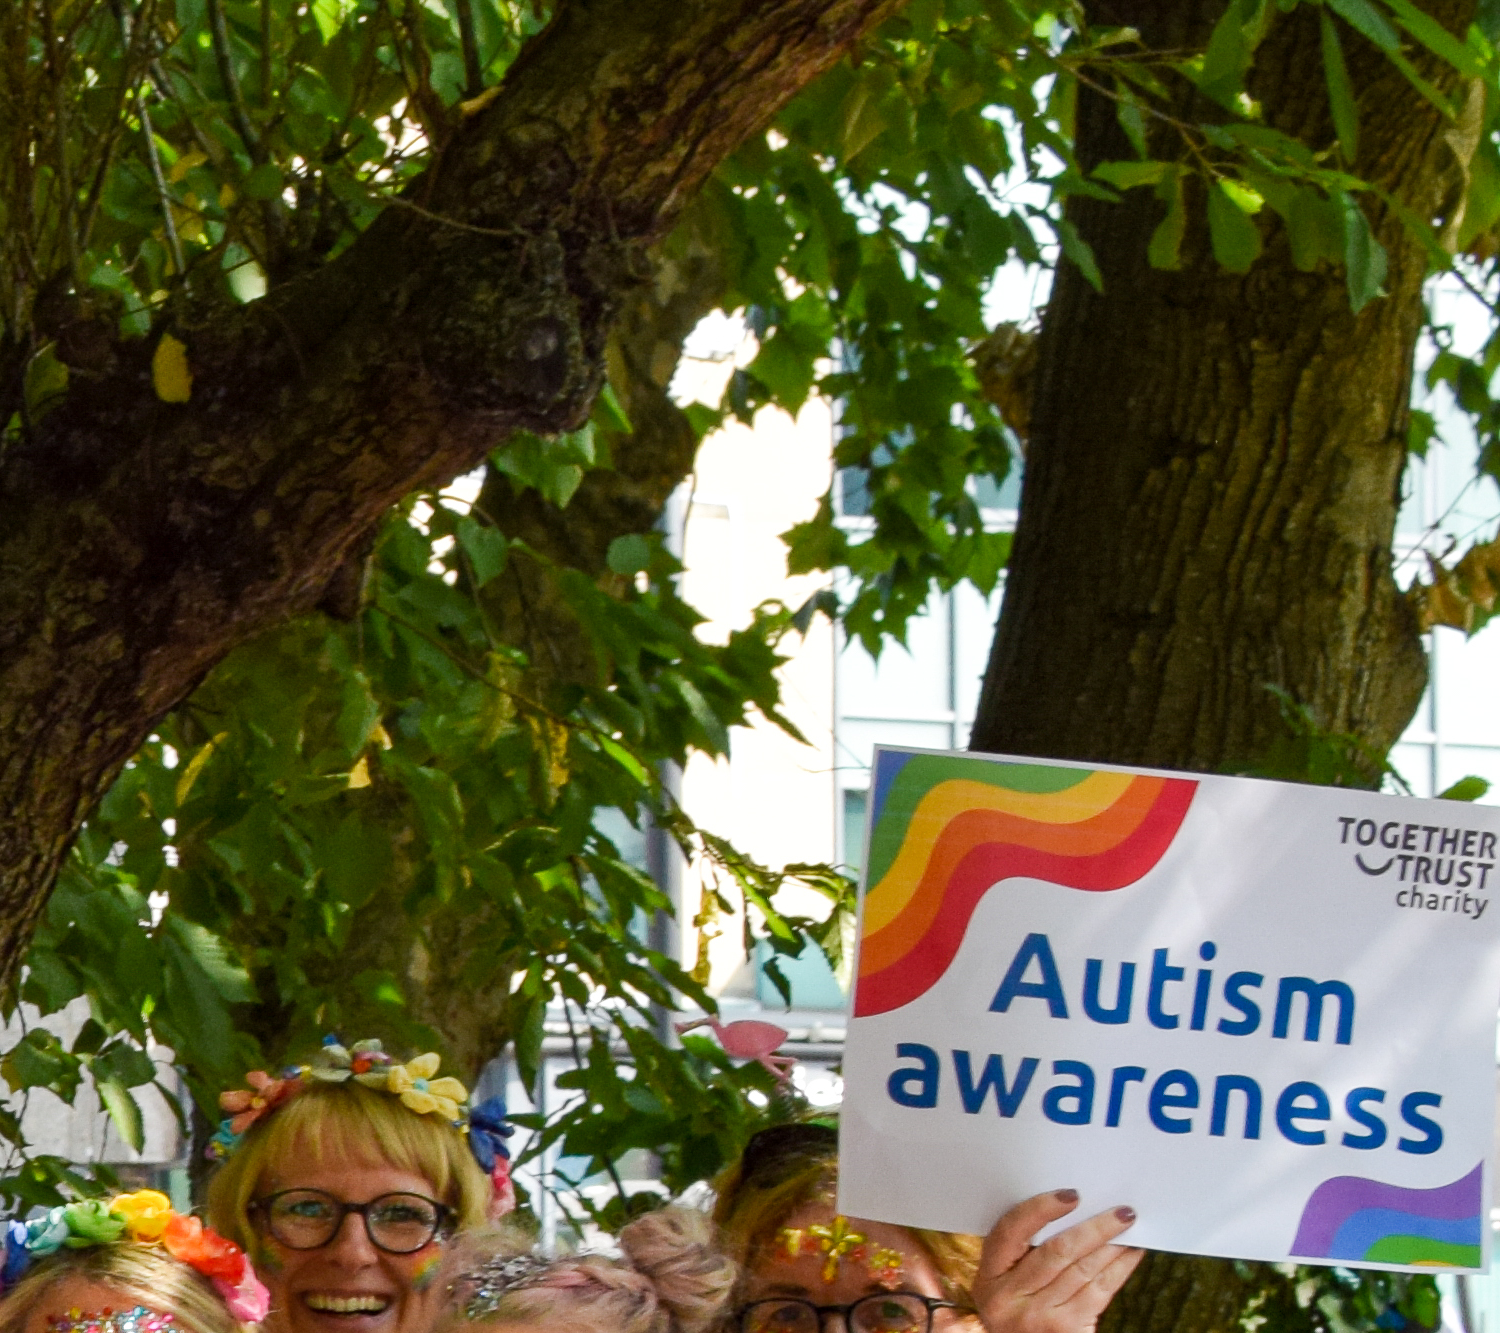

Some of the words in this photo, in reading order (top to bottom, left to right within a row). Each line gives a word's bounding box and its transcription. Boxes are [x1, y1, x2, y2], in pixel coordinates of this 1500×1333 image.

[1338, 816, 1497, 860] TOGETHER
[1395, 853, 1496, 891] TRUST
[1395, 889, 1489, 922] charity
[989, 932, 1357, 1046] Autism
[886, 1041, 1446, 1156] awareness
